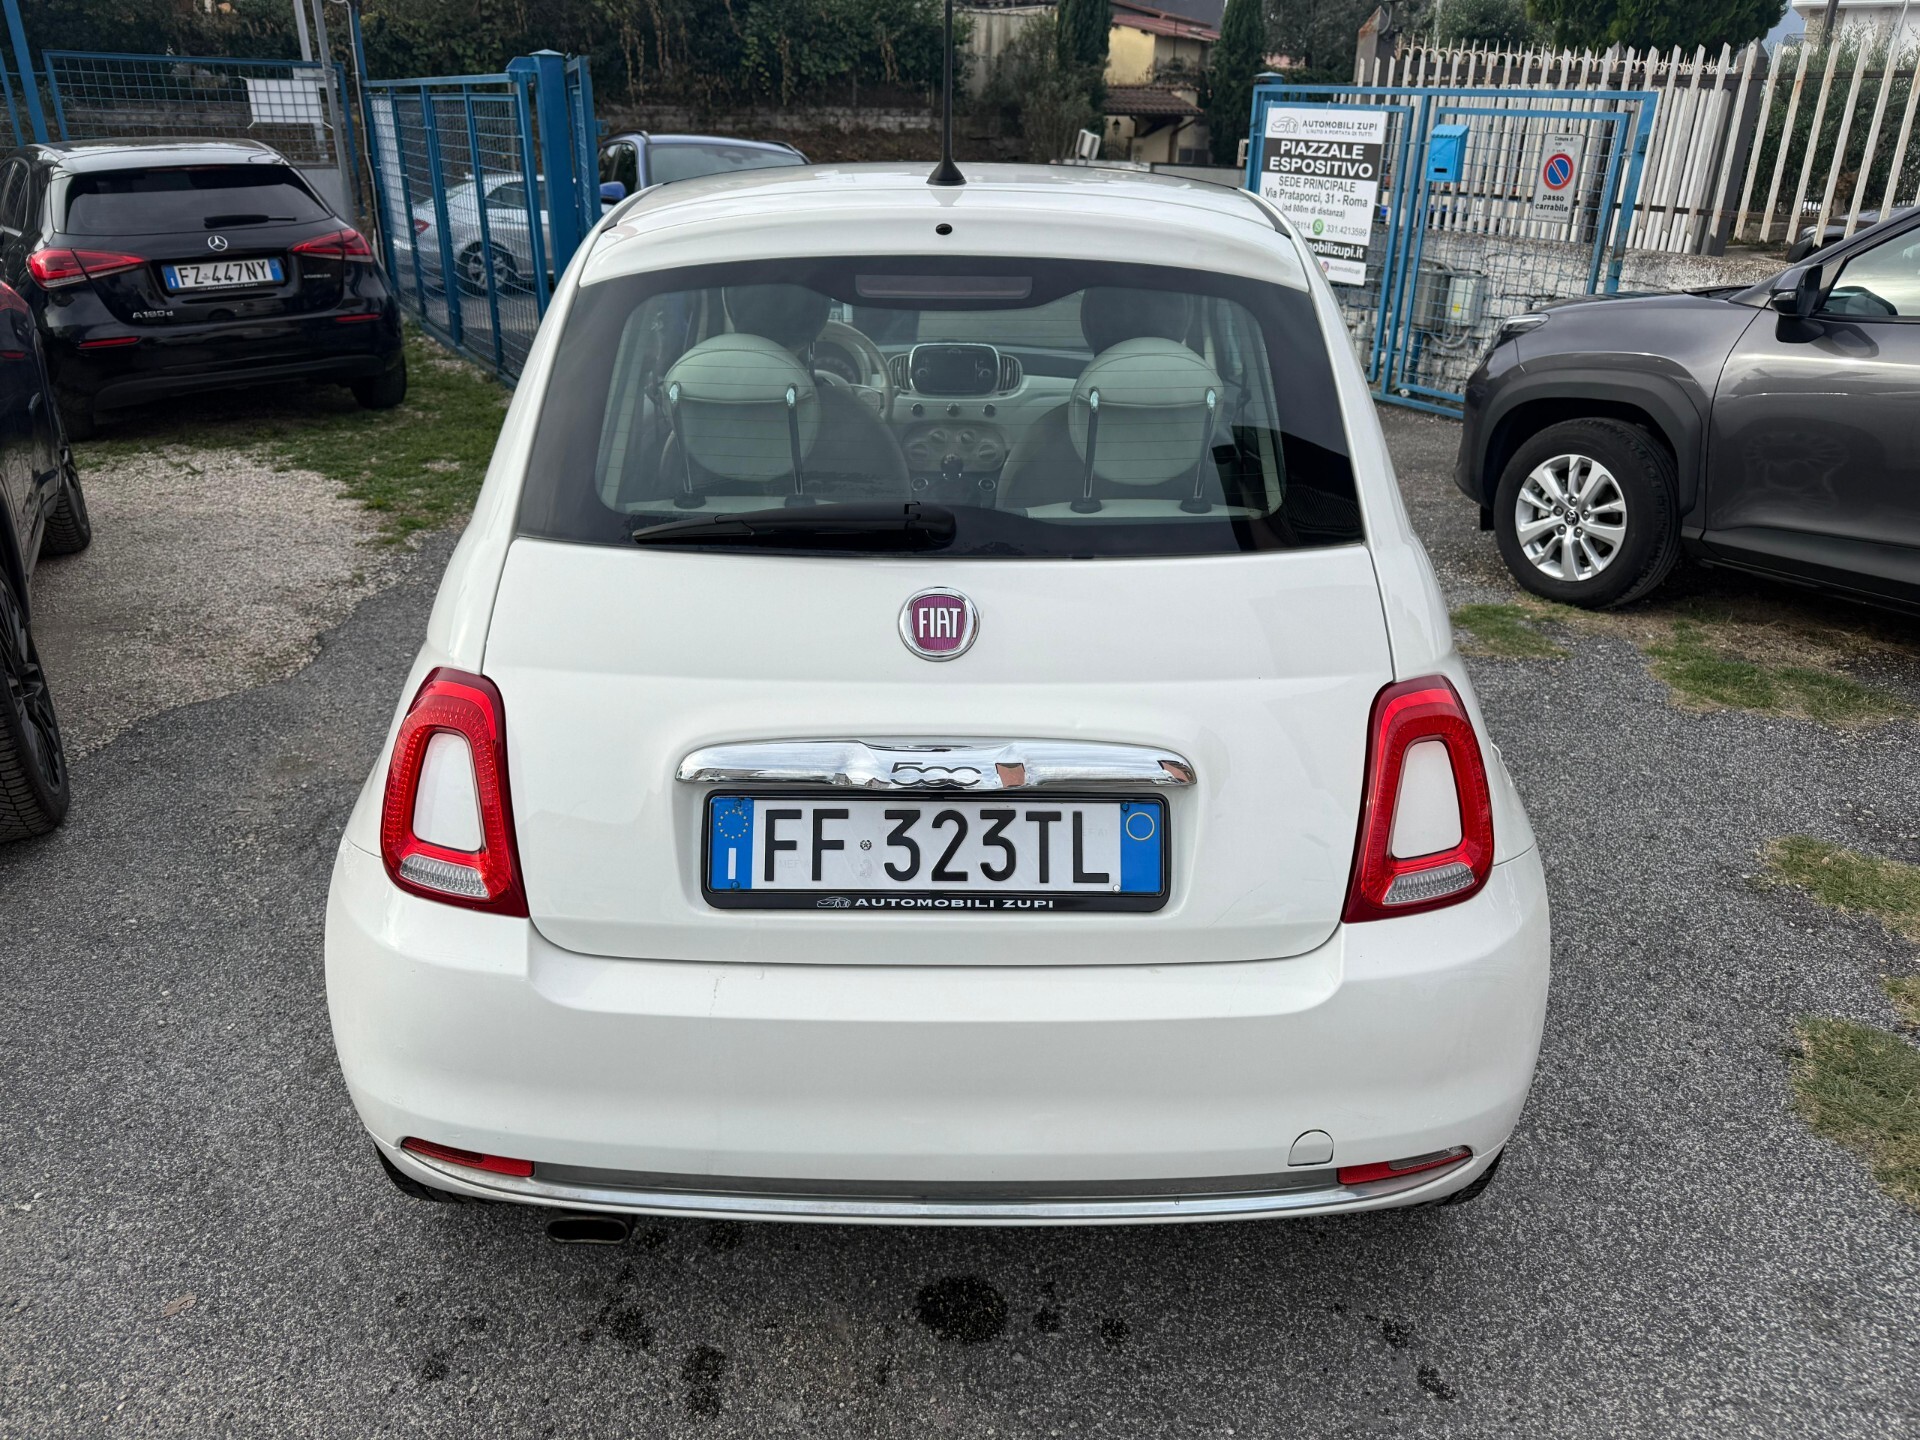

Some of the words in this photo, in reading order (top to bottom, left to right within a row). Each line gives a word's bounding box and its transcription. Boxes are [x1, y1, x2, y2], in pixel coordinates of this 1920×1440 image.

[1302, 119, 1354, 130] AUTOMOBILI
[1357, 123, 1378, 131] ZUPI
[1280, 140, 1365, 160] PIAZZALE
[1269, 156, 1373, 178] ESPOSITIVO
[1278, 175, 1301, 188] SEDE
[1303, 177, 1356, 193] PRINCIPALE
[1265, 187, 1277, 199] Via
[1279, 188, 1322, 205] Prataporci,
[1324, 193, 1335, 204] 31
[1342, 195, 1368, 208] Roma
[1542, 194, 1565, 202] passo
[1281, 203, 1291, 213] (ad
[1309, 206, 1316, 214] di
[1317, 207, 1346, 219] distanza)
[1535, 203, 1569, 213] carrabile
[178, 266, 204, 286] FZ
[211, 261, 269, 283] 447NY
[918, 607, 962, 638] FIAT
[890, 761, 982, 787] 500
[764, 808, 849, 882] FF
[884, 808, 1110, 884] 323TL
[855, 898, 995, 909] AUTOMOBILI
[1002, 899, 1054, 909] ZUPI
